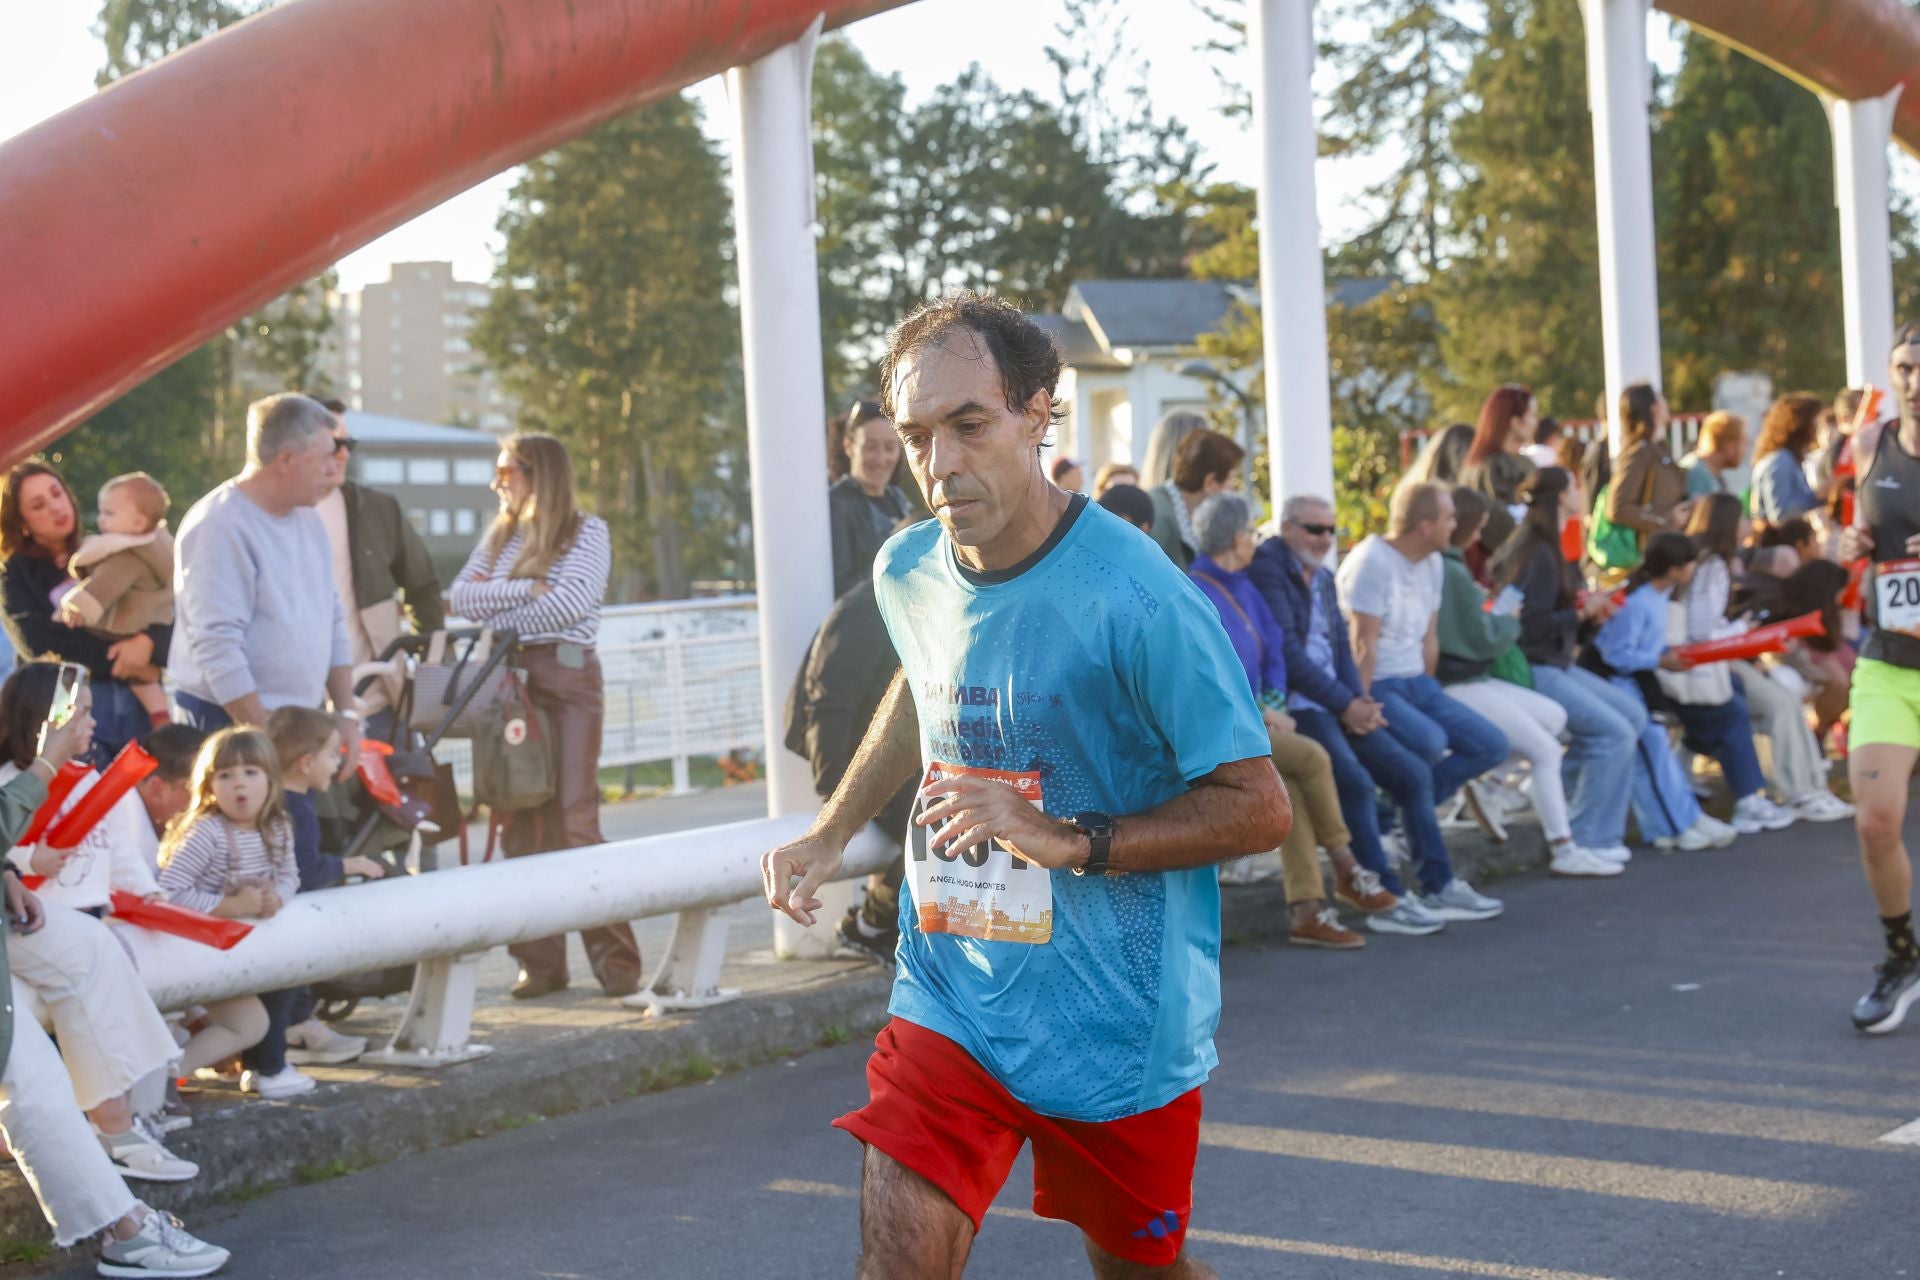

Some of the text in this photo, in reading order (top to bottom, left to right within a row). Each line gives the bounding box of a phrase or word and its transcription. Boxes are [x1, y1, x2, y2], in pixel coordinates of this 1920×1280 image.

[929, 875, 1006, 891] ANGEL HUGO MONTES
